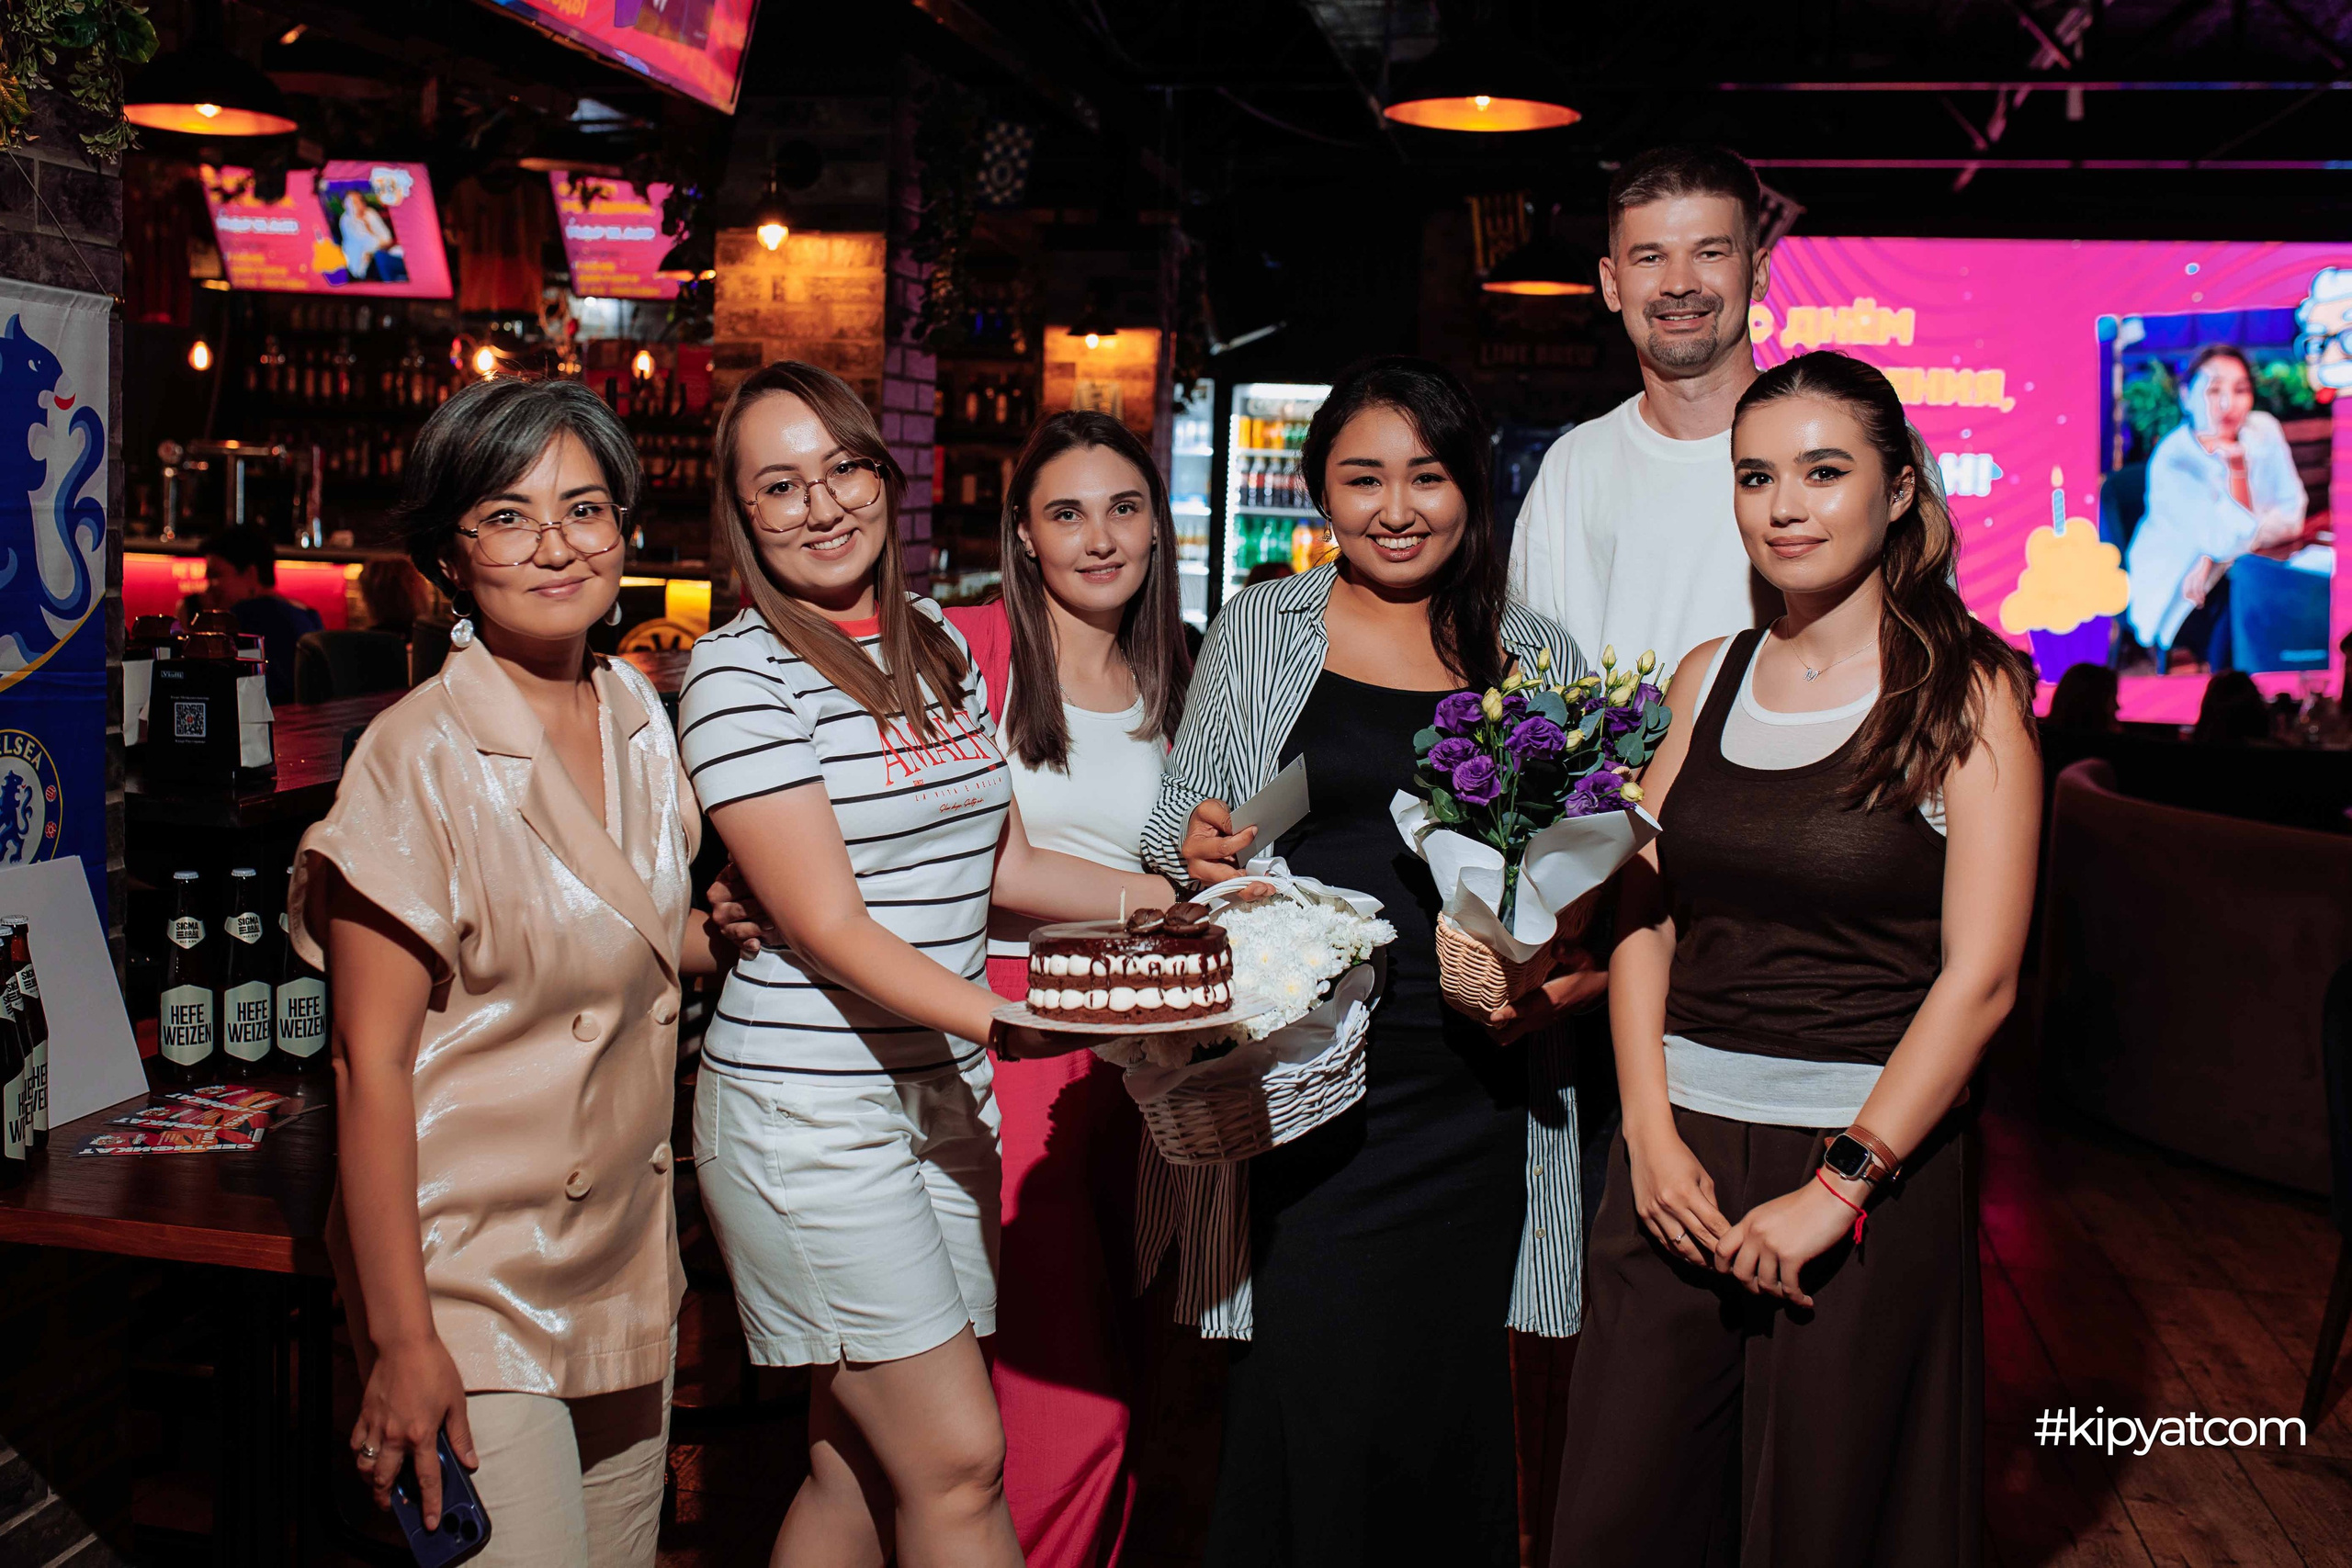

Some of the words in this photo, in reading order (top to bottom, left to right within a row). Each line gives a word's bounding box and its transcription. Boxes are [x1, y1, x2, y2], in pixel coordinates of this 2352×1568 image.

[1780, 298, 1916, 348] ДНЁМ
[1886, 367, 2016, 412] ЕНИЯ,
[0, 735, 42, 771] LSEA
[915, 794, 926, 802] LA
[934, 788, 958, 797] VITA
[238, 917, 258, 926] SIGMA
[171, 1003, 204, 1025] HEFE
[237, 999, 267, 1021] HEFE
[288, 996, 320, 1018] HEFE
[163, 1022, 211, 1045] WEIZEN
[79, 1143, 255, 1155] СЕРТИФИКАТ
